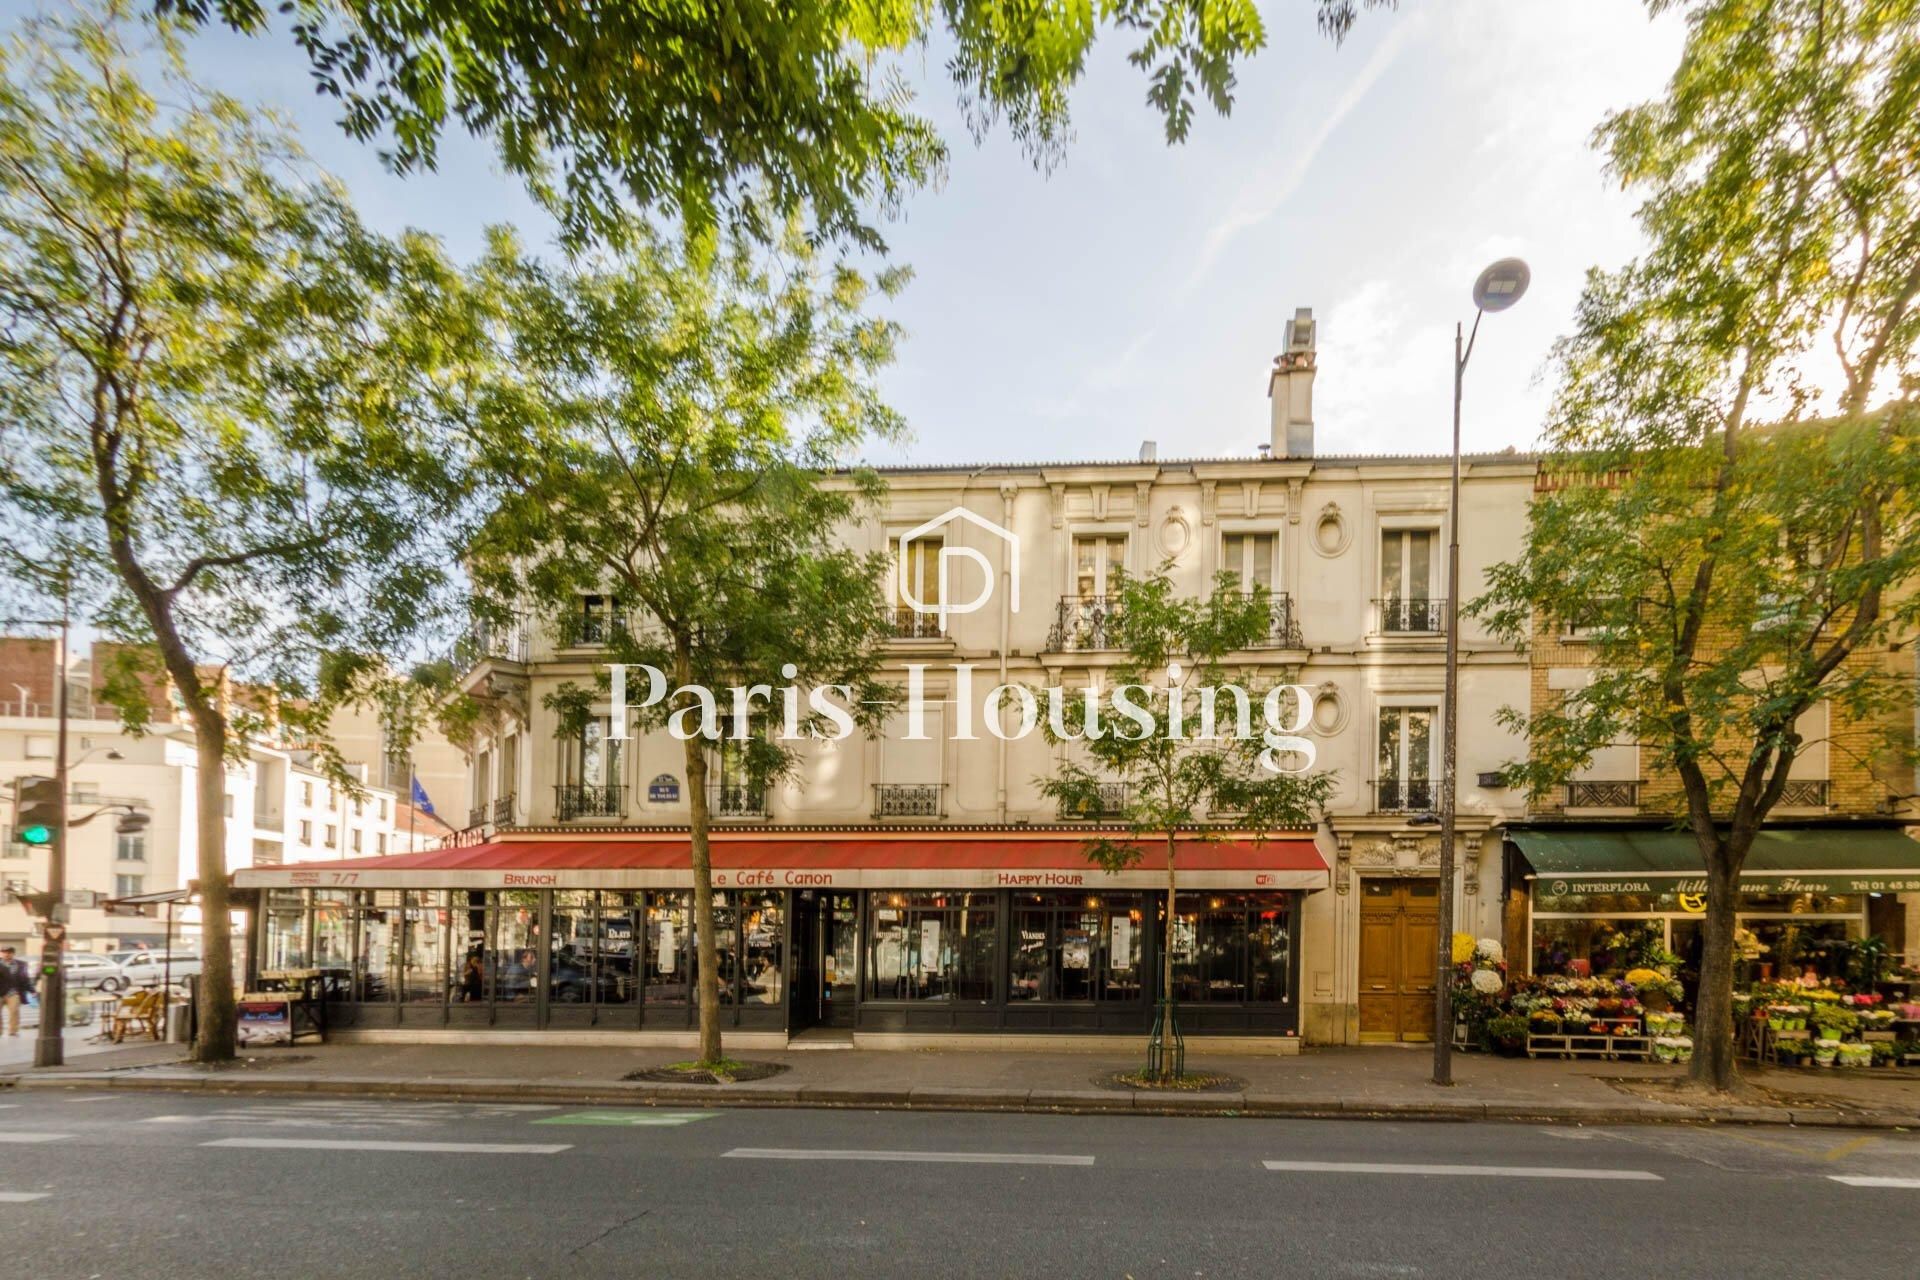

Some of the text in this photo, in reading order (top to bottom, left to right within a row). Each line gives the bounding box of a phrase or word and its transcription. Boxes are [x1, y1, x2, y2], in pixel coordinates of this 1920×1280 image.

[332, 872, 359, 884] 7/7
[503, 874, 557, 885] BRUNCH
[711, 871, 832, 885] e Café Canon
[998, 873, 1083, 885] HAPPY HOUR
[1572, 883, 1651, 893] INTERFLORA
[1778, 878, 1829, 892] Fleurs
[1851, 881, 1869, 890] Tél
[1871, 881, 1885, 890] 01
[1888, 881, 1903, 890] 45
